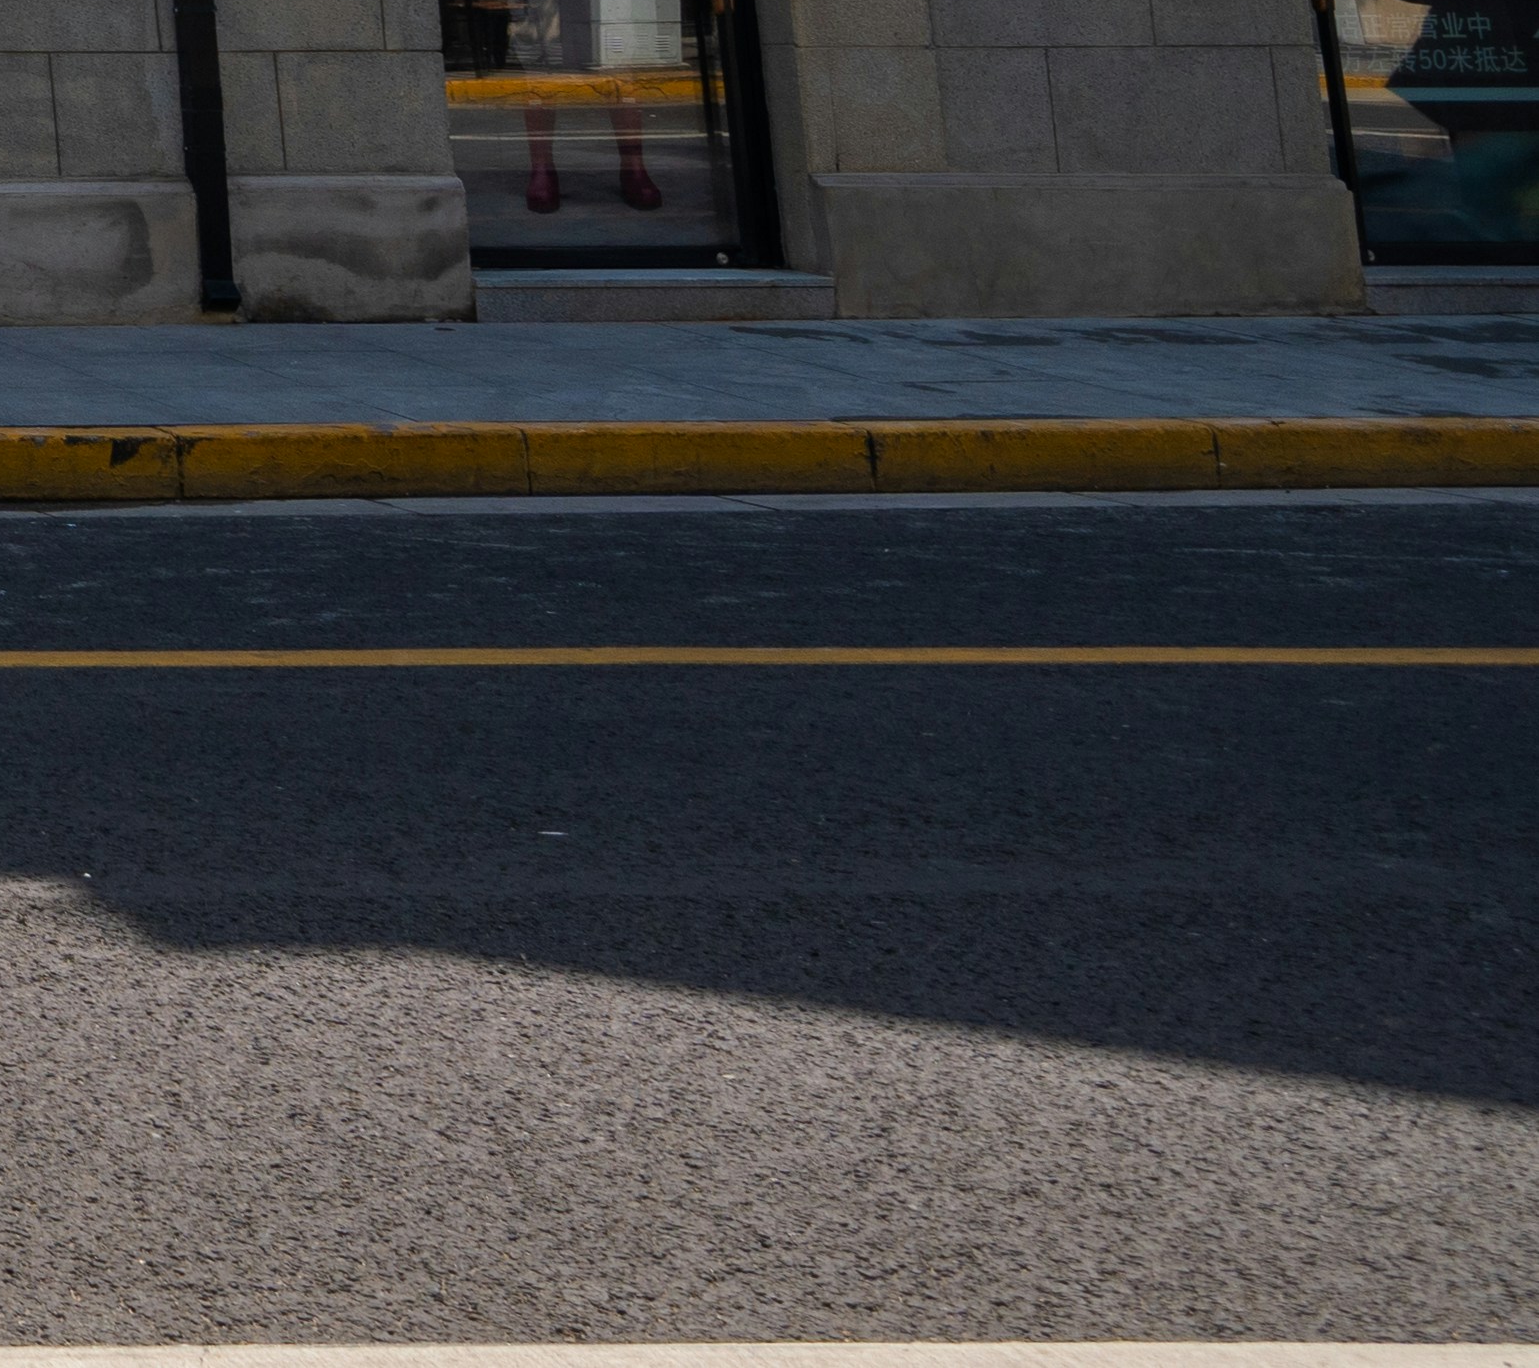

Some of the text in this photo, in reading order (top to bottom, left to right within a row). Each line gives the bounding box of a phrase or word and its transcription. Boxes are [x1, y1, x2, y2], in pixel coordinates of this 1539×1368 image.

[1315, 45, 1528, 73] 方左转50米抵达
